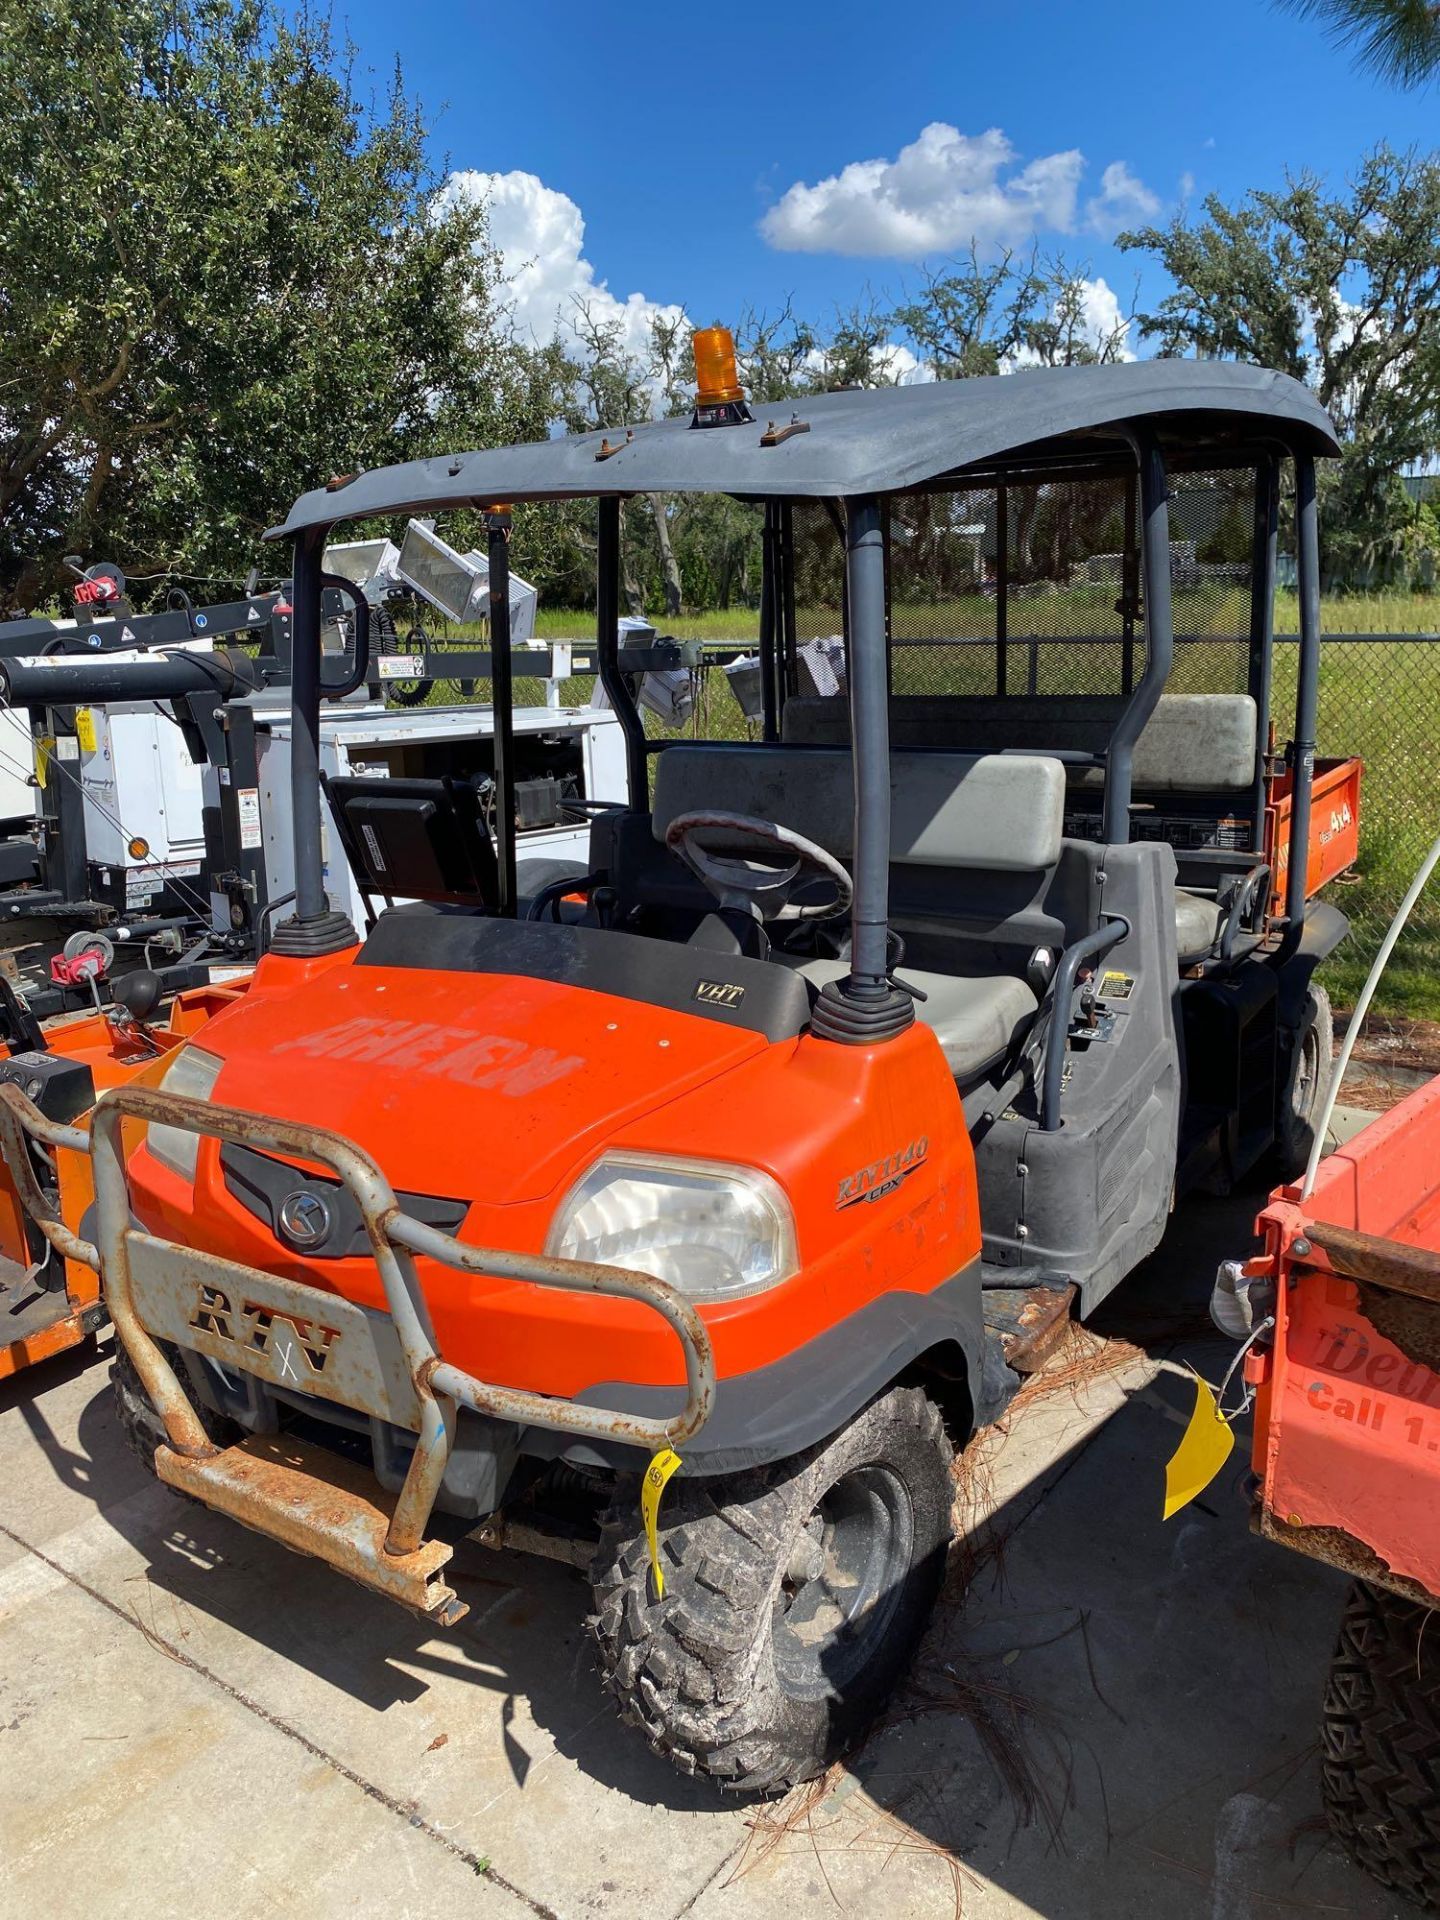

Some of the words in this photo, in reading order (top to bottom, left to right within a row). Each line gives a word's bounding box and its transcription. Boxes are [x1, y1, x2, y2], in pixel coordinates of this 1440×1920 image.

[1330, 802, 1352, 832] 4x4
[696, 981, 742, 1002] VHT
[270, 1016, 586, 1097] AHERN
[836, 1135, 928, 1204] RTV1140
[870, 1175, 903, 1200] CPX
[1307, 1382, 1387, 1432] Call
